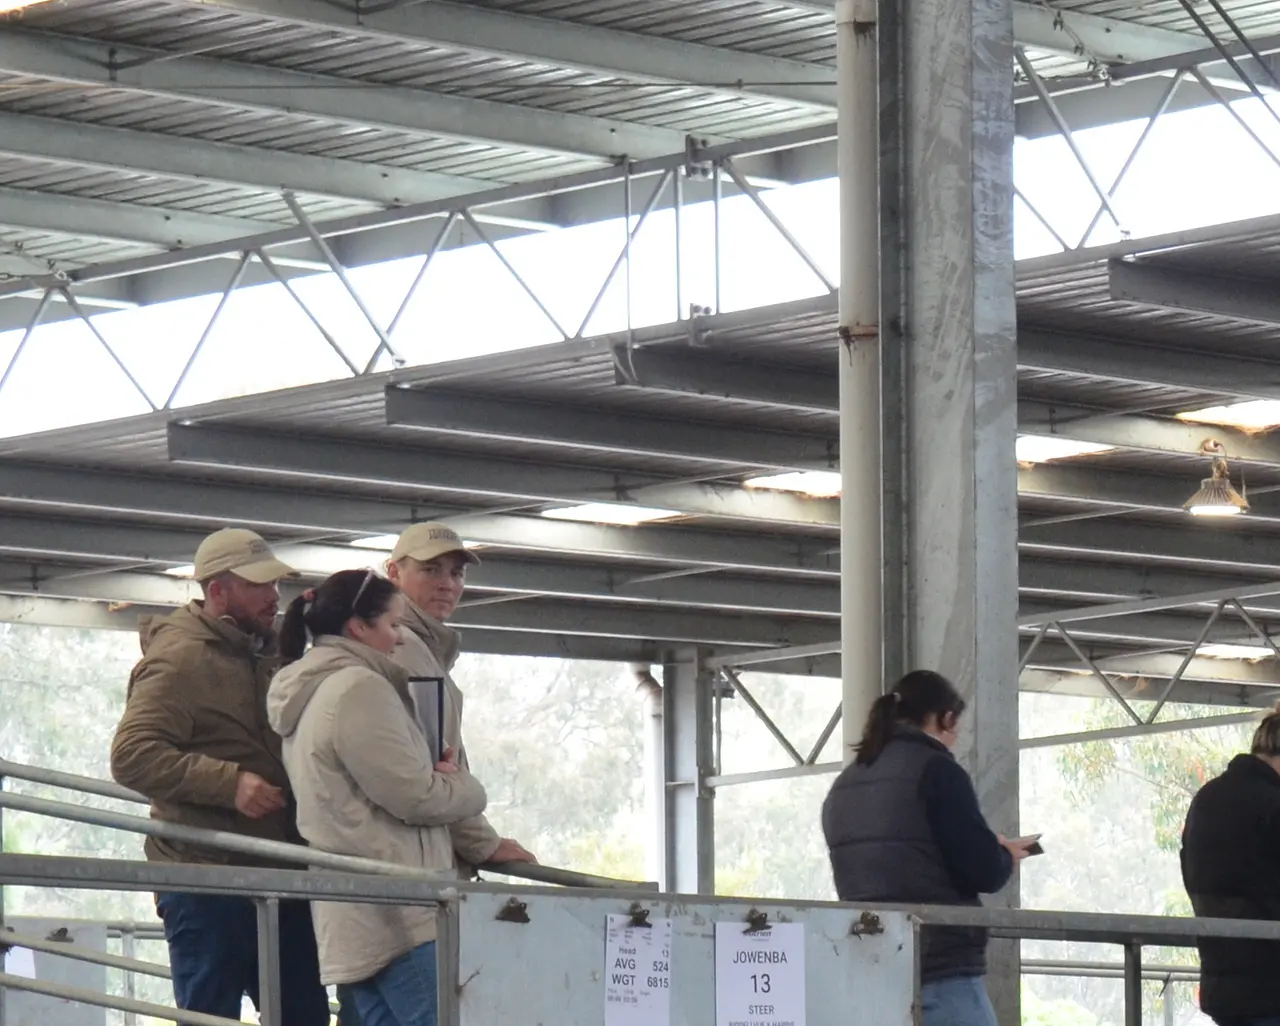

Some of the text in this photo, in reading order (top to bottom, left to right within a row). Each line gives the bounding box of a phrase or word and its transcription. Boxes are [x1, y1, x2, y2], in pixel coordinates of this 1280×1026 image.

[733, 951, 788, 964] JOWENBA
[614, 958, 669, 972] AVG 524
[611, 973, 669, 988] WGT 6815
[750, 973, 771, 994] 13
[748, 1005, 774, 1015] STEER
